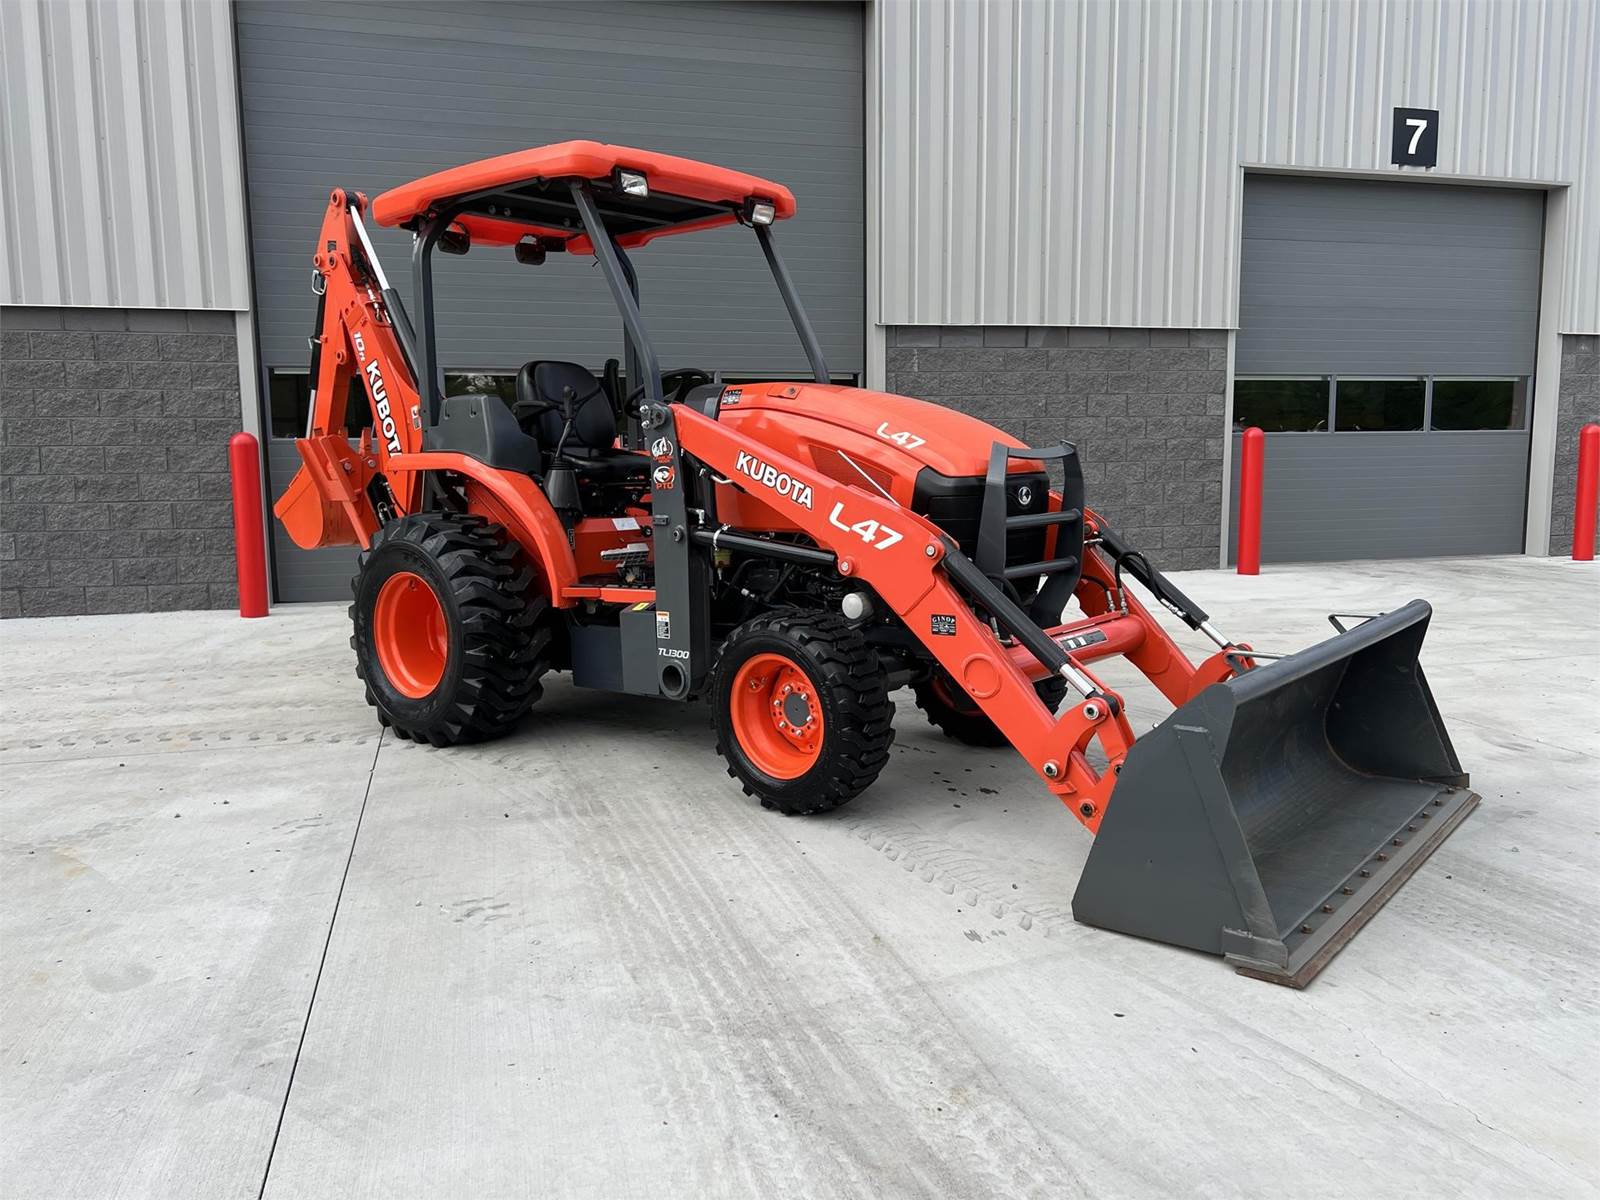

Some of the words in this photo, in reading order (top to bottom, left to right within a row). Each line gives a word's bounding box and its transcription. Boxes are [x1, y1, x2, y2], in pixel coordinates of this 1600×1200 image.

[1405, 118, 1428, 155] 7
[876, 421, 927, 450] L47
[655, 482, 674, 490] PTO
[735, 450, 815, 511] KUBOTA
[828, 501, 904, 551] L47
[657, 647, 690, 659] TL1300
